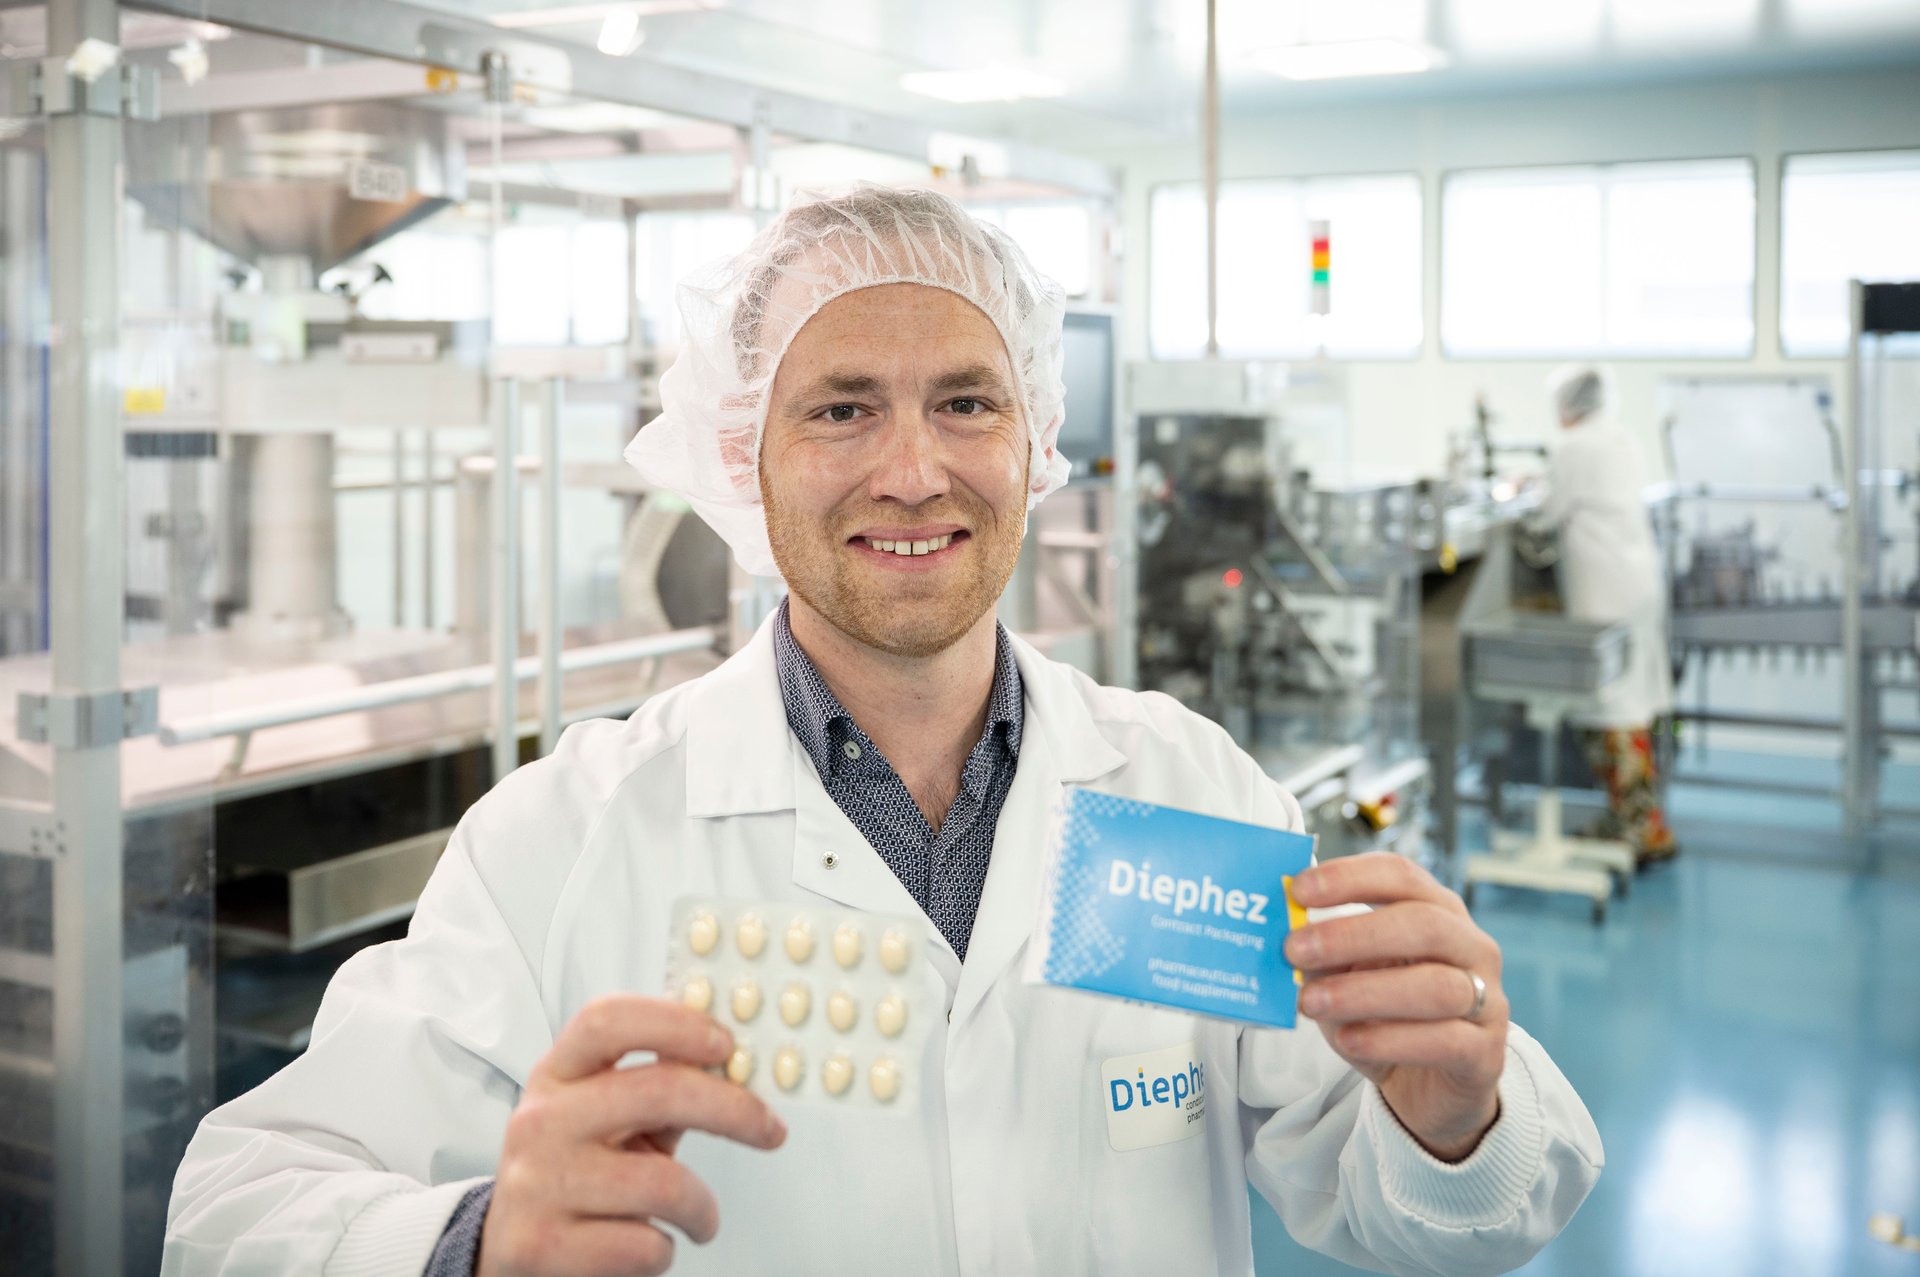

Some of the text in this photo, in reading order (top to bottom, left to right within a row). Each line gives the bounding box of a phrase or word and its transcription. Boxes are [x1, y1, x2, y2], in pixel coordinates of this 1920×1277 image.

[1108, 859, 1269, 924] Diephez
[1150, 914, 1265, 951] Contract Packaging
[1148, 957, 1248, 988] pharmaceuticals
[1152, 972, 1258, 1006] food supplements
[1110, 1061, 1204, 1112] Diephe
